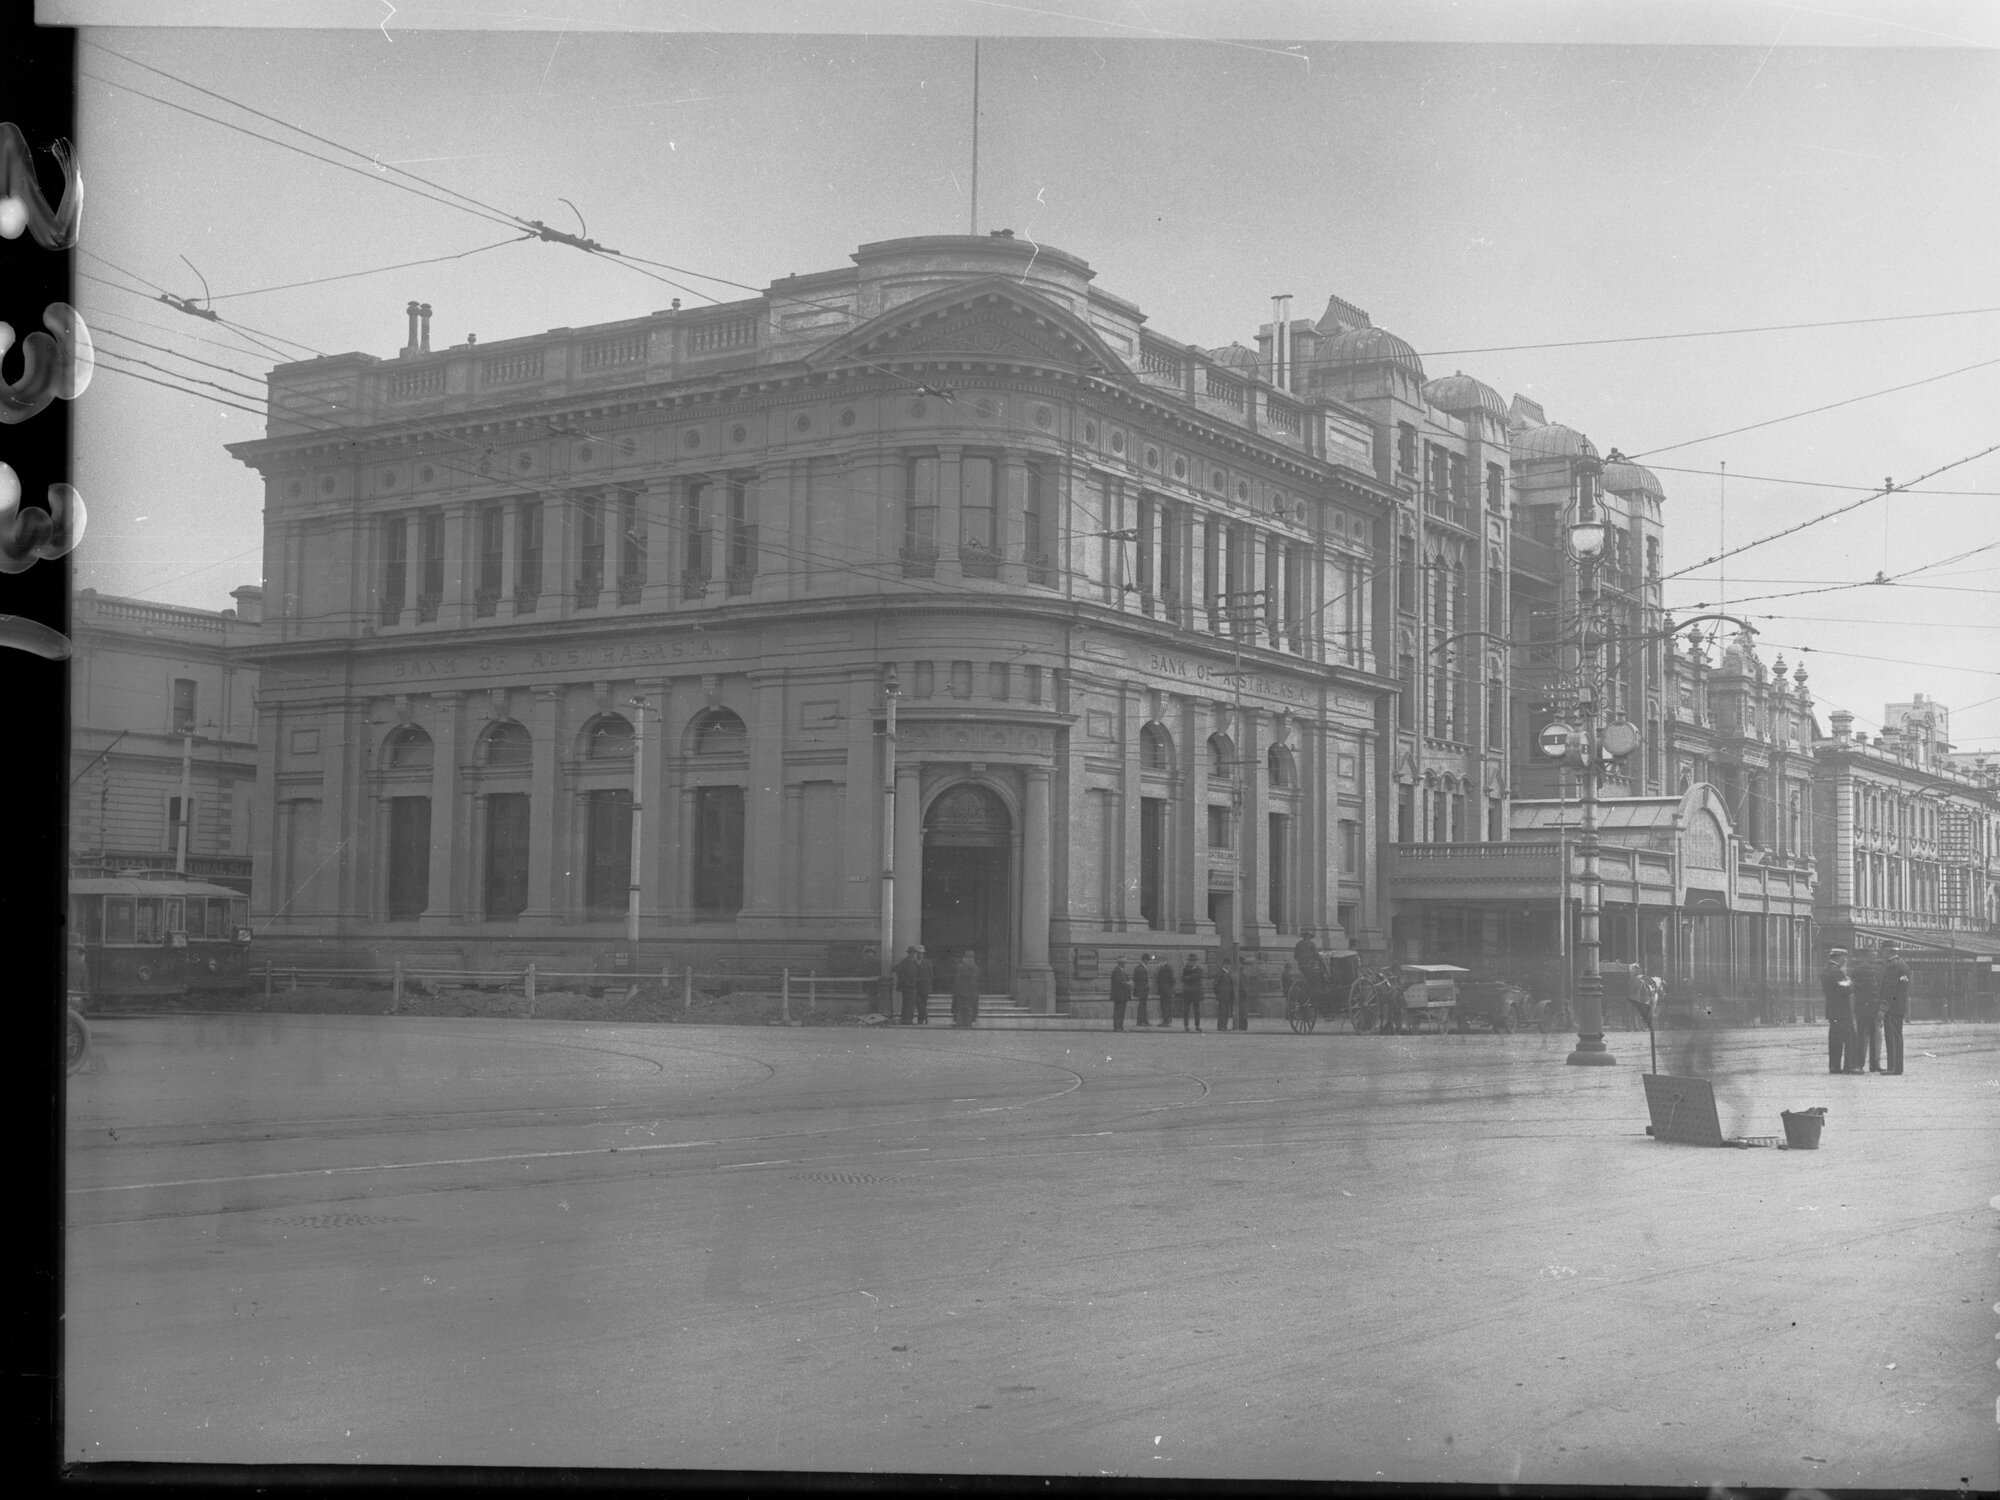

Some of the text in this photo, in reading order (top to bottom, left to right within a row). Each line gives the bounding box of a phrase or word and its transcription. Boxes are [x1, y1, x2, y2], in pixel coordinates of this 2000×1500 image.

[393, 655, 457, 678] BANK
[479, 655, 509, 671] OF
[1151, 654, 1187, 677] BANK
[1197, 664, 1213, 682] OF
